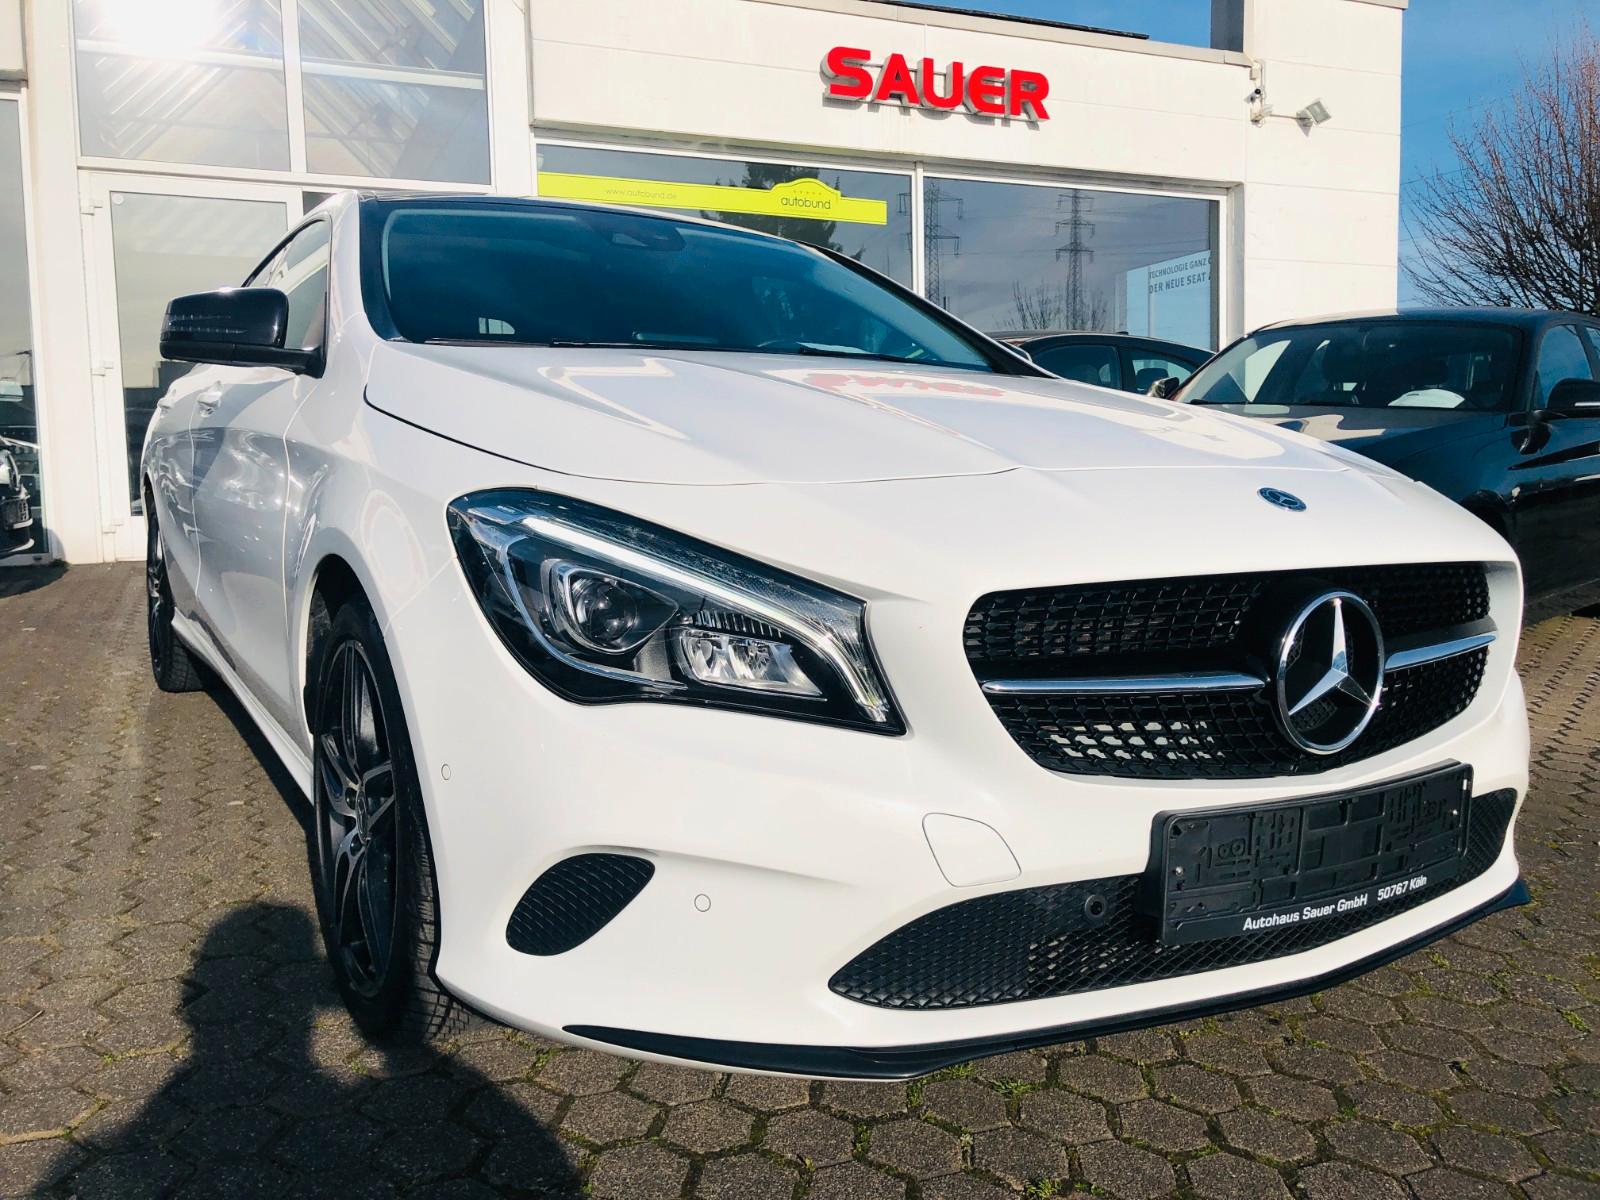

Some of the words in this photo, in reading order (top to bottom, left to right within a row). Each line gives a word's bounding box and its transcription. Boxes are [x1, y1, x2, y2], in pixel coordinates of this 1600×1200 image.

[826, 46, 1050, 120] SAUER
[606, 188, 678, 200] www.autobund.de
[781, 196, 831, 210] autobund
[1148, 262, 1188, 279] TECHNOLOGIE
[1189, 257, 1207, 270] GANZ
[1148, 281, 1163, 294] DER
[1165, 276, 1185, 290] NEUE
[1186, 271, 1206, 285] SEAT
[1243, 911, 1300, 931] Autohaus
[1302, 904, 1335, 920] Sauer
[1337, 893, 1368, 912] GmbH
[1377, 882, 1408, 901] 50767
[1409, 874, 1428, 890] Köln
